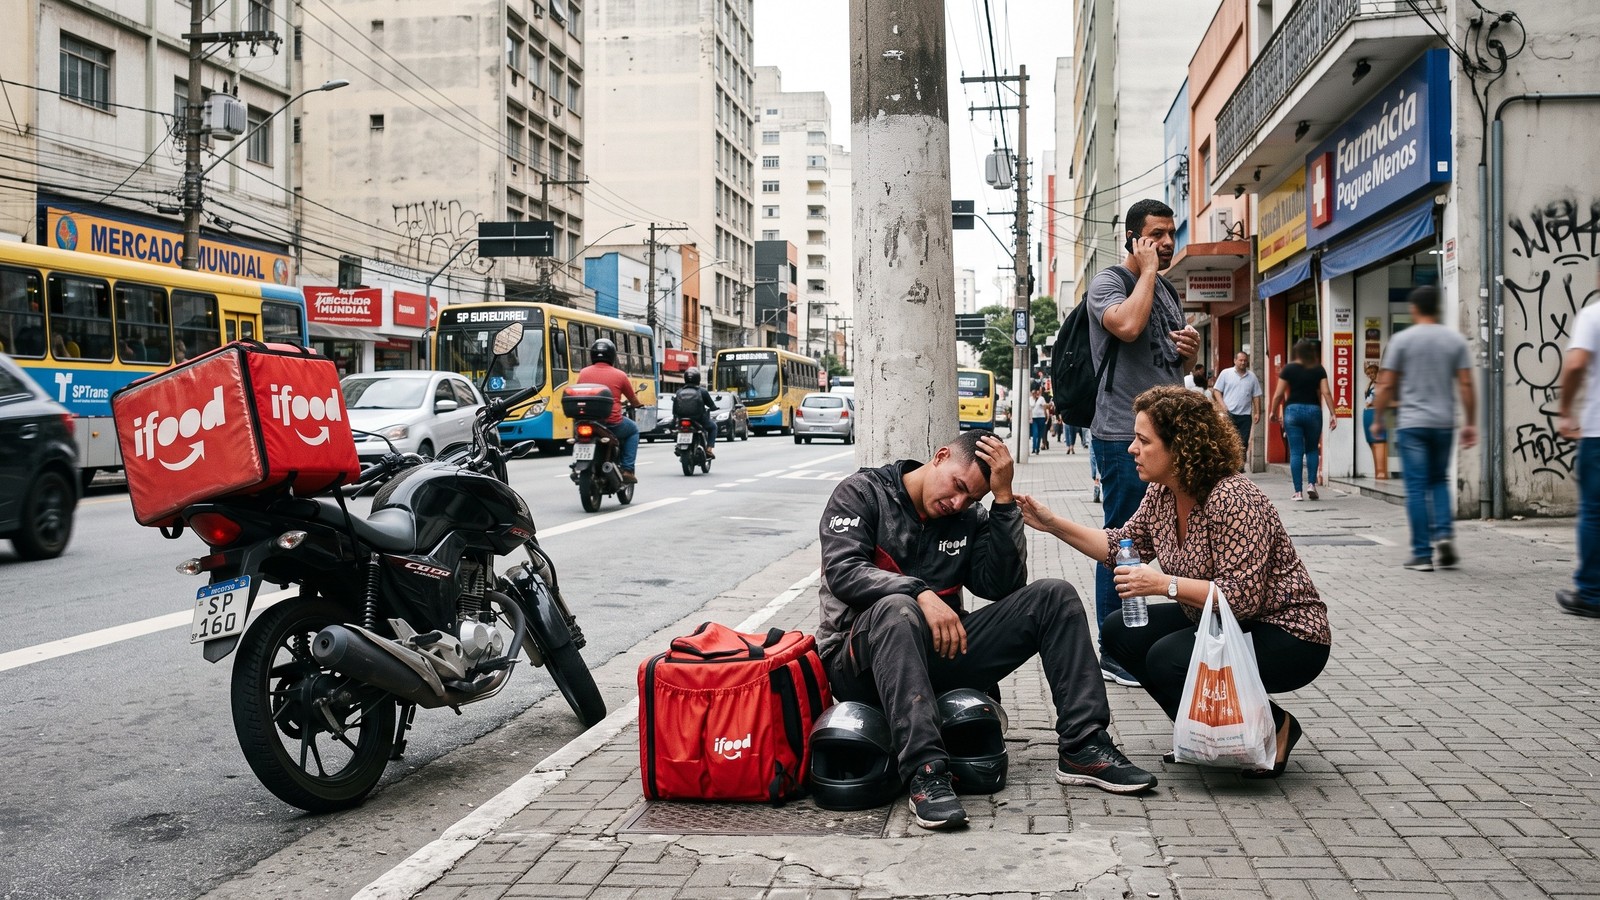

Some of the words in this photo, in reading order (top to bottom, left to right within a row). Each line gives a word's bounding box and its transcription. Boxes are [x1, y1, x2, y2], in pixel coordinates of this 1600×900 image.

[1336, 89, 1416, 180] Farmácia
[321, 306, 371, 315] MUNDIAL
[72, 385, 109, 398] SPTrans
[270, 384, 342, 426] ifood
[133, 385, 226, 461] ifood
[829, 515, 861, 529] ifood
[938, 536, 967, 552] ifood
[208, 593, 233, 615] SP
[199, 612, 236, 638] 160
[714, 733, 751, 754] ifood
